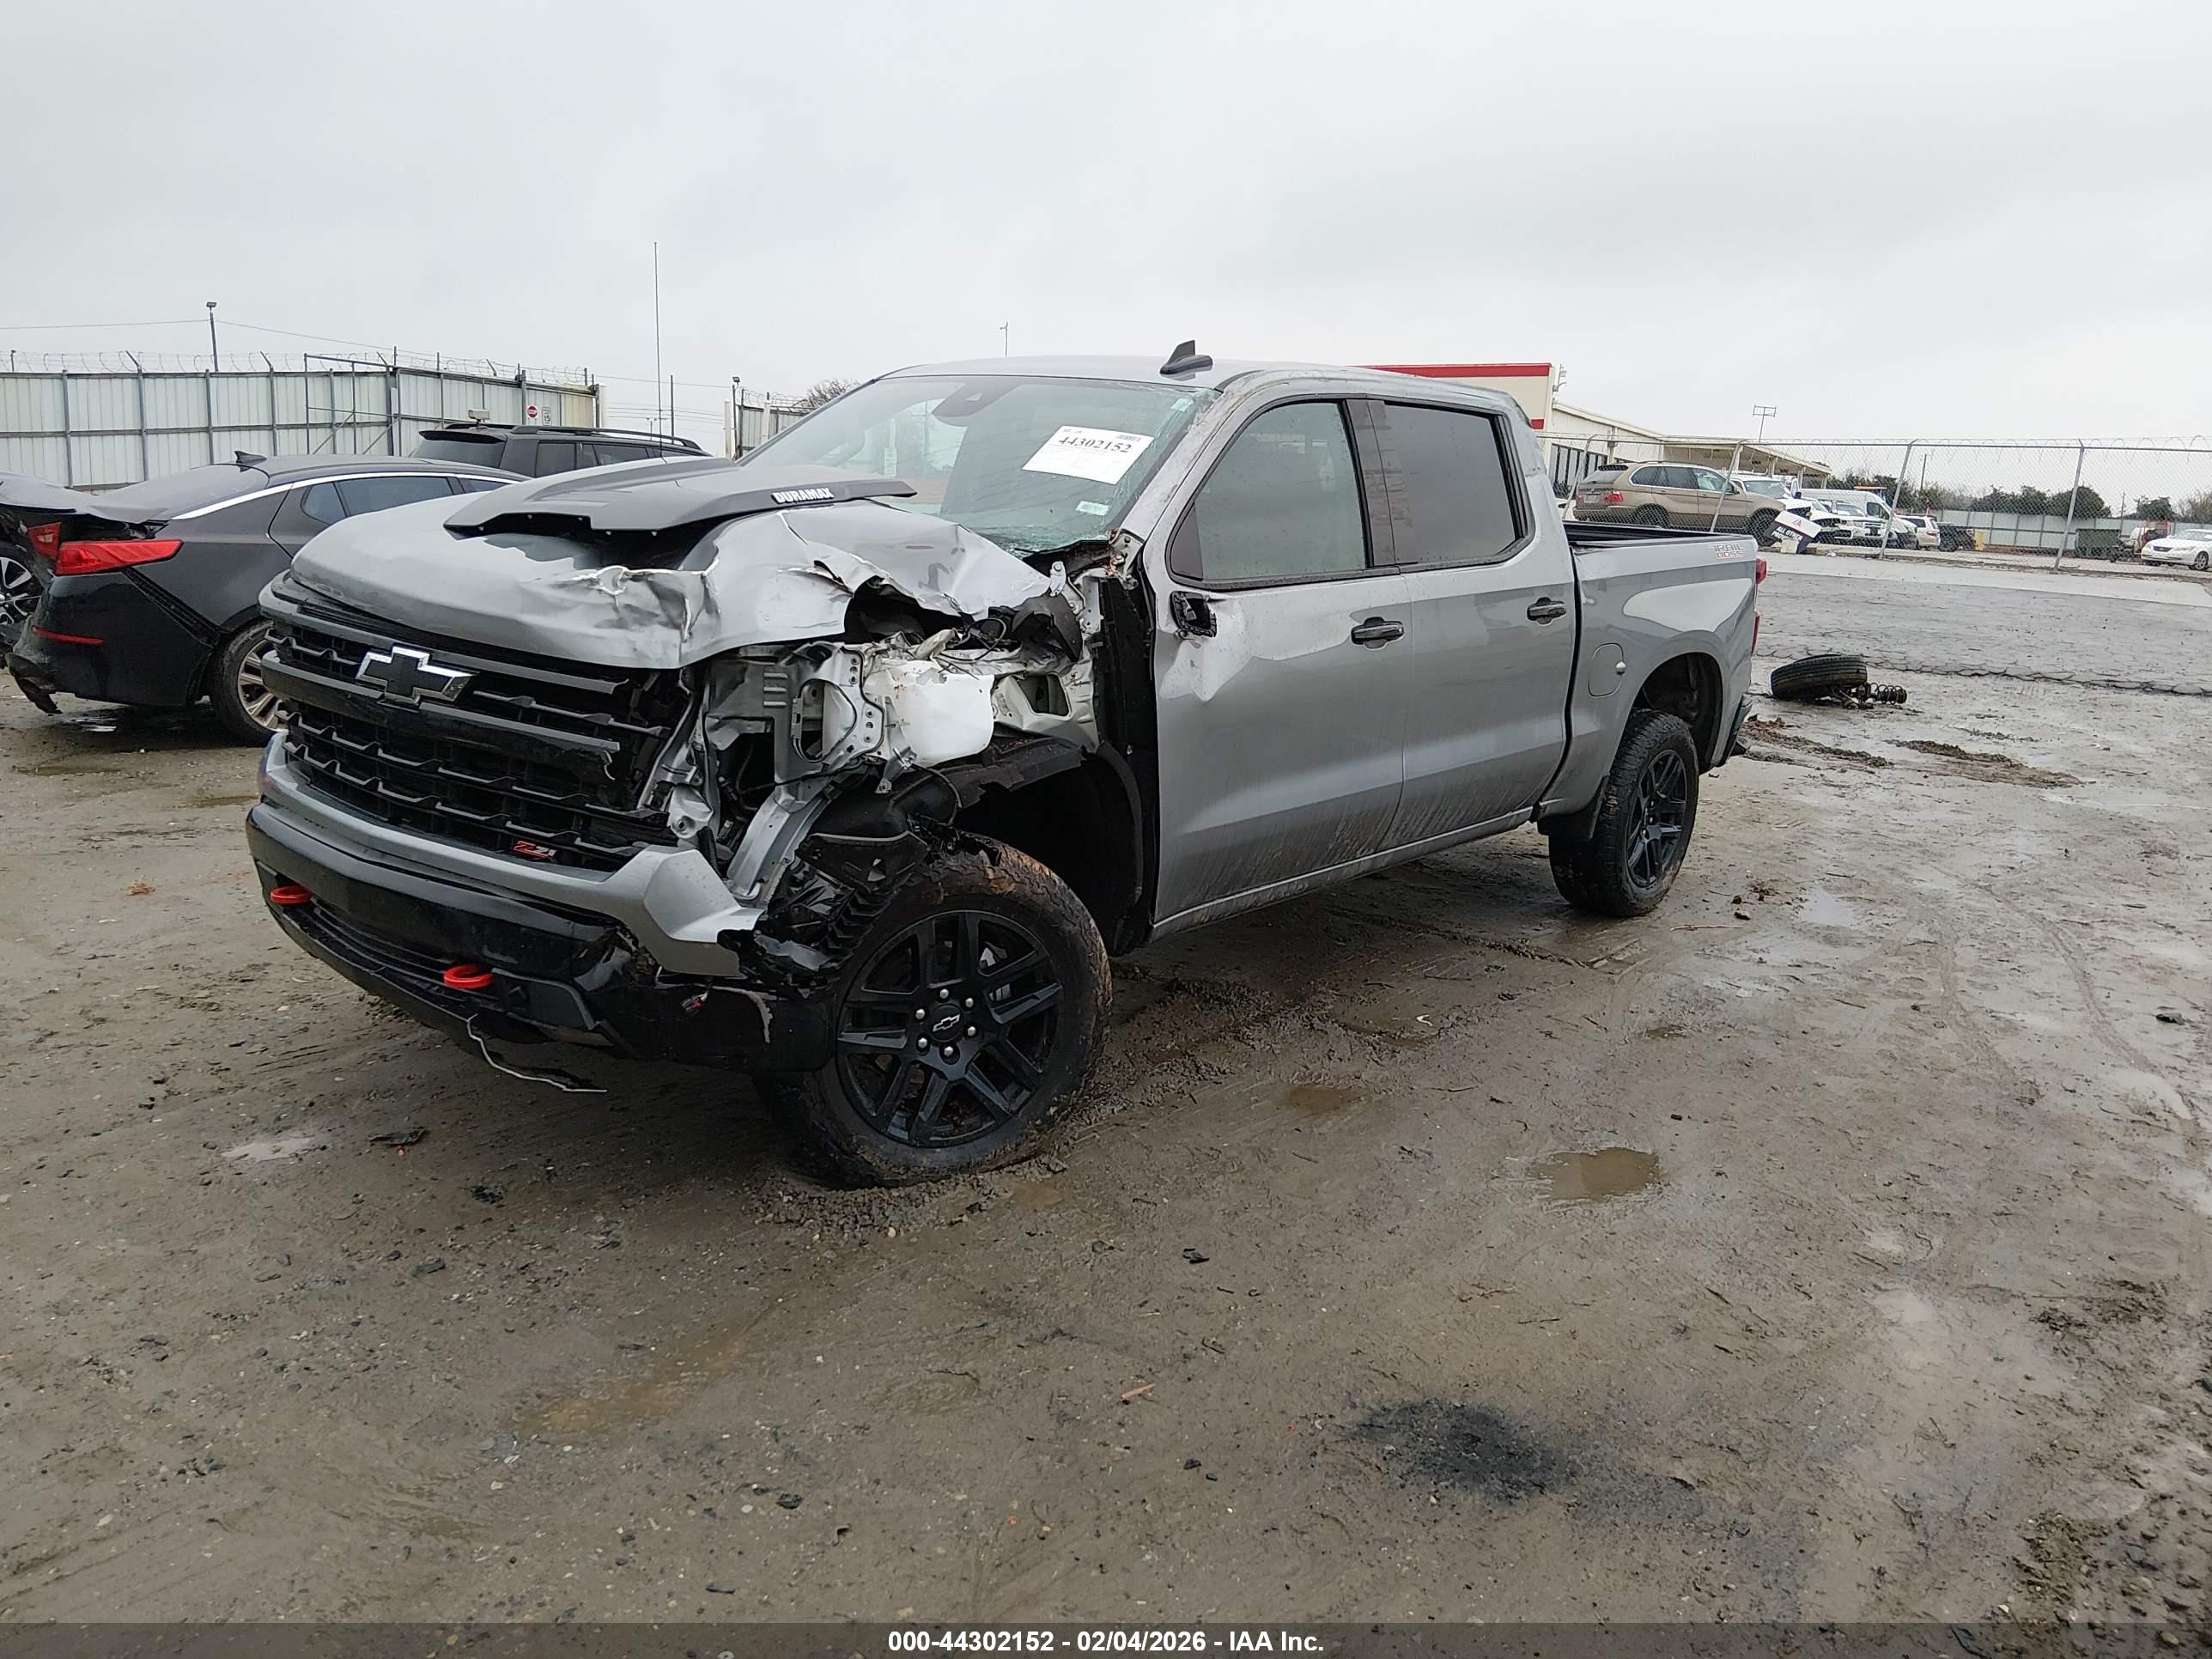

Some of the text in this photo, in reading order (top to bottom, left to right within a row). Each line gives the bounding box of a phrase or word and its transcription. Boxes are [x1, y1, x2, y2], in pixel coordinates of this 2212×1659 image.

[1058, 436, 1133, 453] 44302152
[771, 487, 835, 504] DURAMAX
[1776, 526, 1786, 534] ALL
[1713, 544, 1745, 552] TRAIL
[514, 840, 557, 858] Z71
